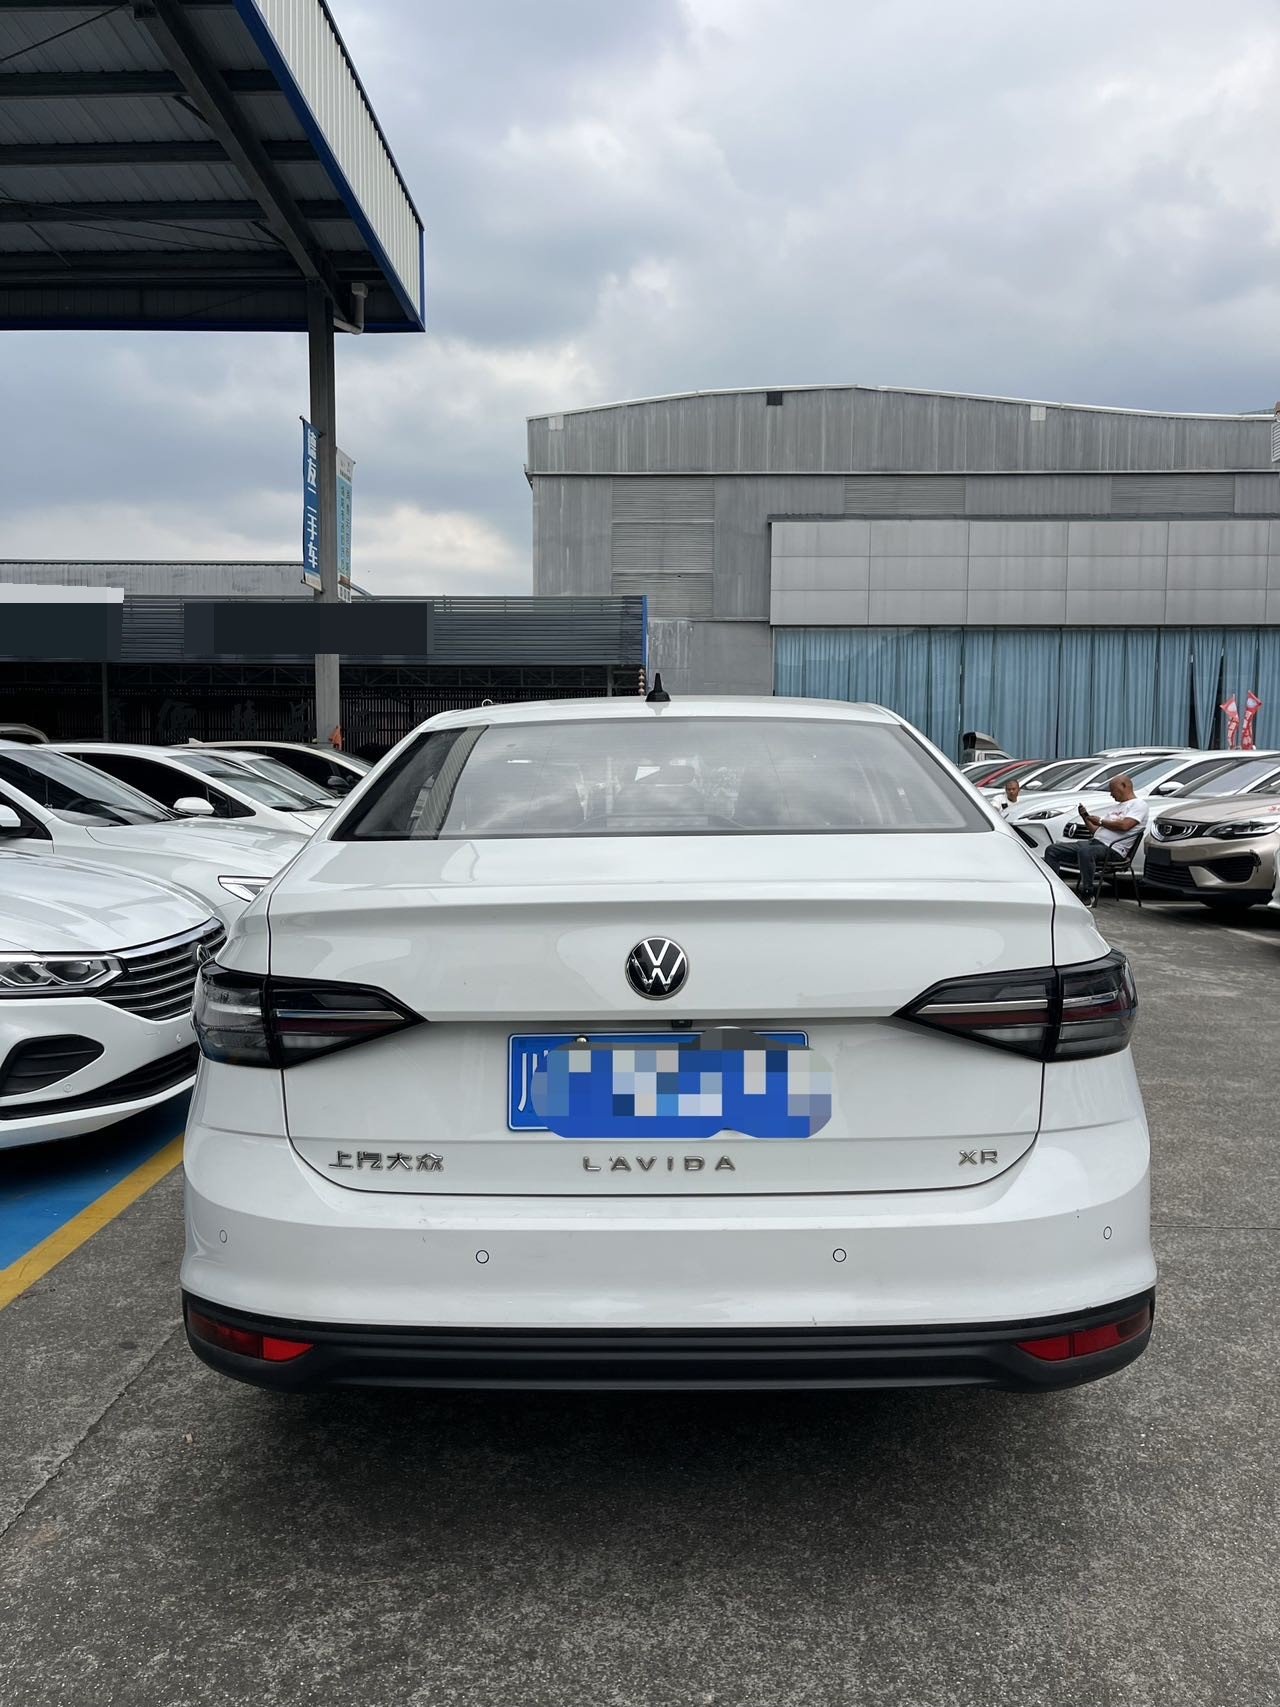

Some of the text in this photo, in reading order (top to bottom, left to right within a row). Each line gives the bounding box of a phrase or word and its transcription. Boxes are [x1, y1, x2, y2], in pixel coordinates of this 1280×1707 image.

[328, 1150, 444, 1170] 上汽大众
[582, 1155, 736, 1172] LAVIDA
[958, 1149, 998, 1166] XR
